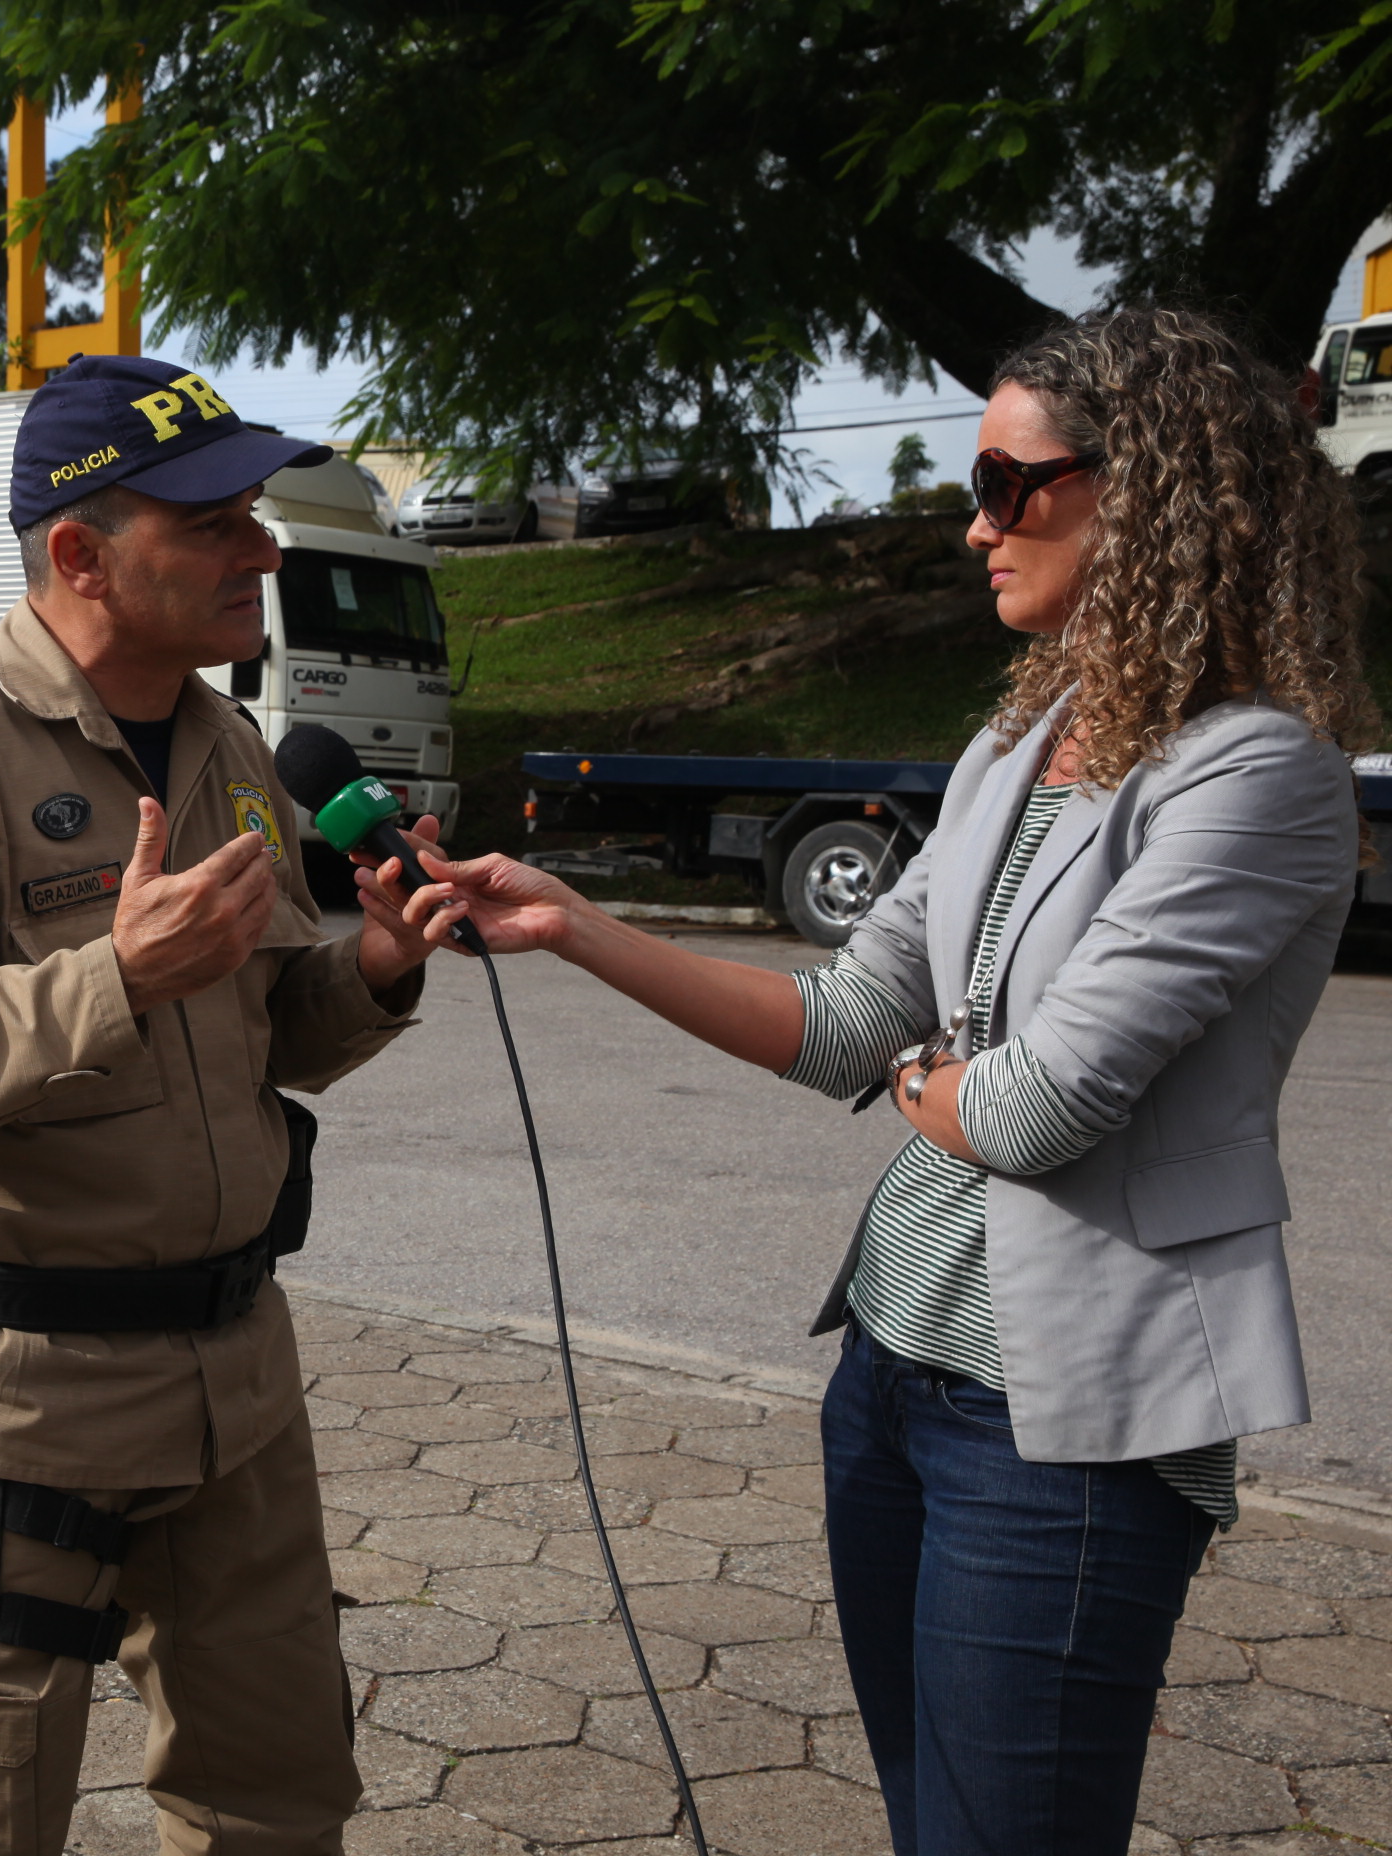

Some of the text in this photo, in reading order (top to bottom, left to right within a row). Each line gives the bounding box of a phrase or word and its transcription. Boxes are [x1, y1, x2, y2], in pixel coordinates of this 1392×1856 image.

[130, 373, 232, 442] PR
[50, 445, 120, 488] POLÍCIA
[293, 668, 347, 685] CARGO
[233, 788, 264, 803] POLÍCIA
[34, 876, 101, 906] GRAZIANO
